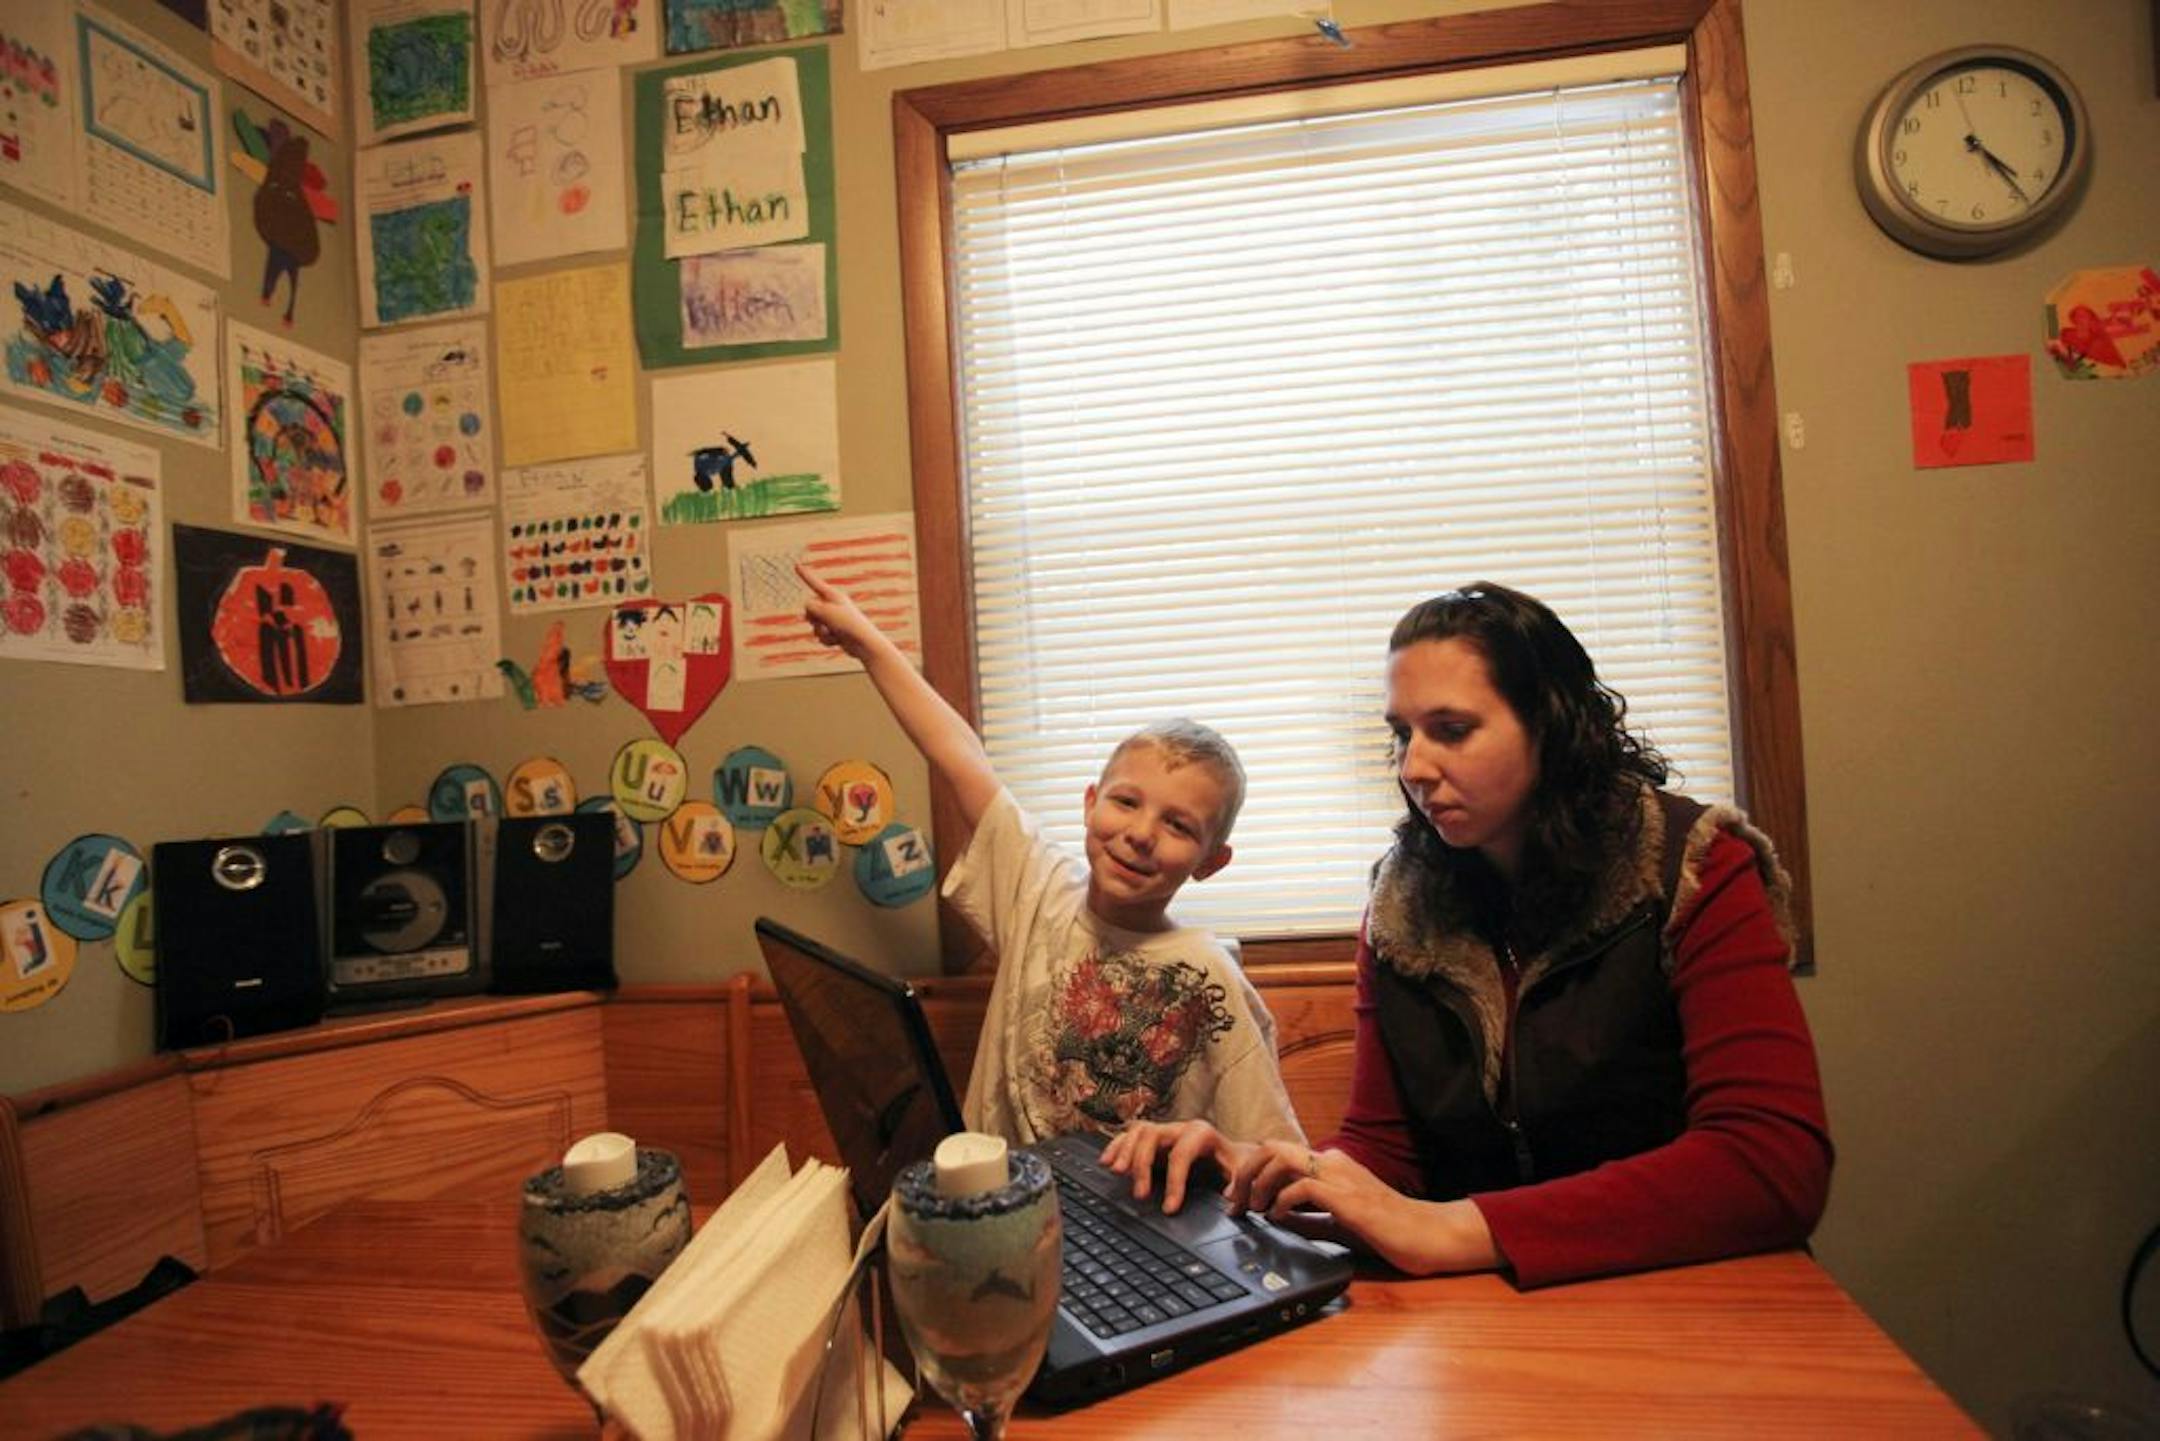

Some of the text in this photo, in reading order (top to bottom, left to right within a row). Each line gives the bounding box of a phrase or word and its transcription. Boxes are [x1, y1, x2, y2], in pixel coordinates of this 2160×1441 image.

[1958, 75, 1976, 94] 12
[1926, 91, 1940, 109] 11
[2031, 99, 2042, 117] 2
[673, 92, 782, 134] Ethan
[1903, 118, 1920, 136] 10
[1896, 150, 1907, 168] 9
[678, 188, 790, 232] Ethan
[1936, 199, 1950, 217] 7
[1971, 202, 1985, 220] 6
[621, 752, 664, 801] U u
[514, 777, 559, 812] S s
[755, 782, 779, 802] w
[854, 792, 874, 822] y
[668, 819, 695, 854] V
[770, 823, 800, 862] X
[897, 841, 921, 861] z
[96, 866, 123, 908] k
[22, 909, 47, 974] j
